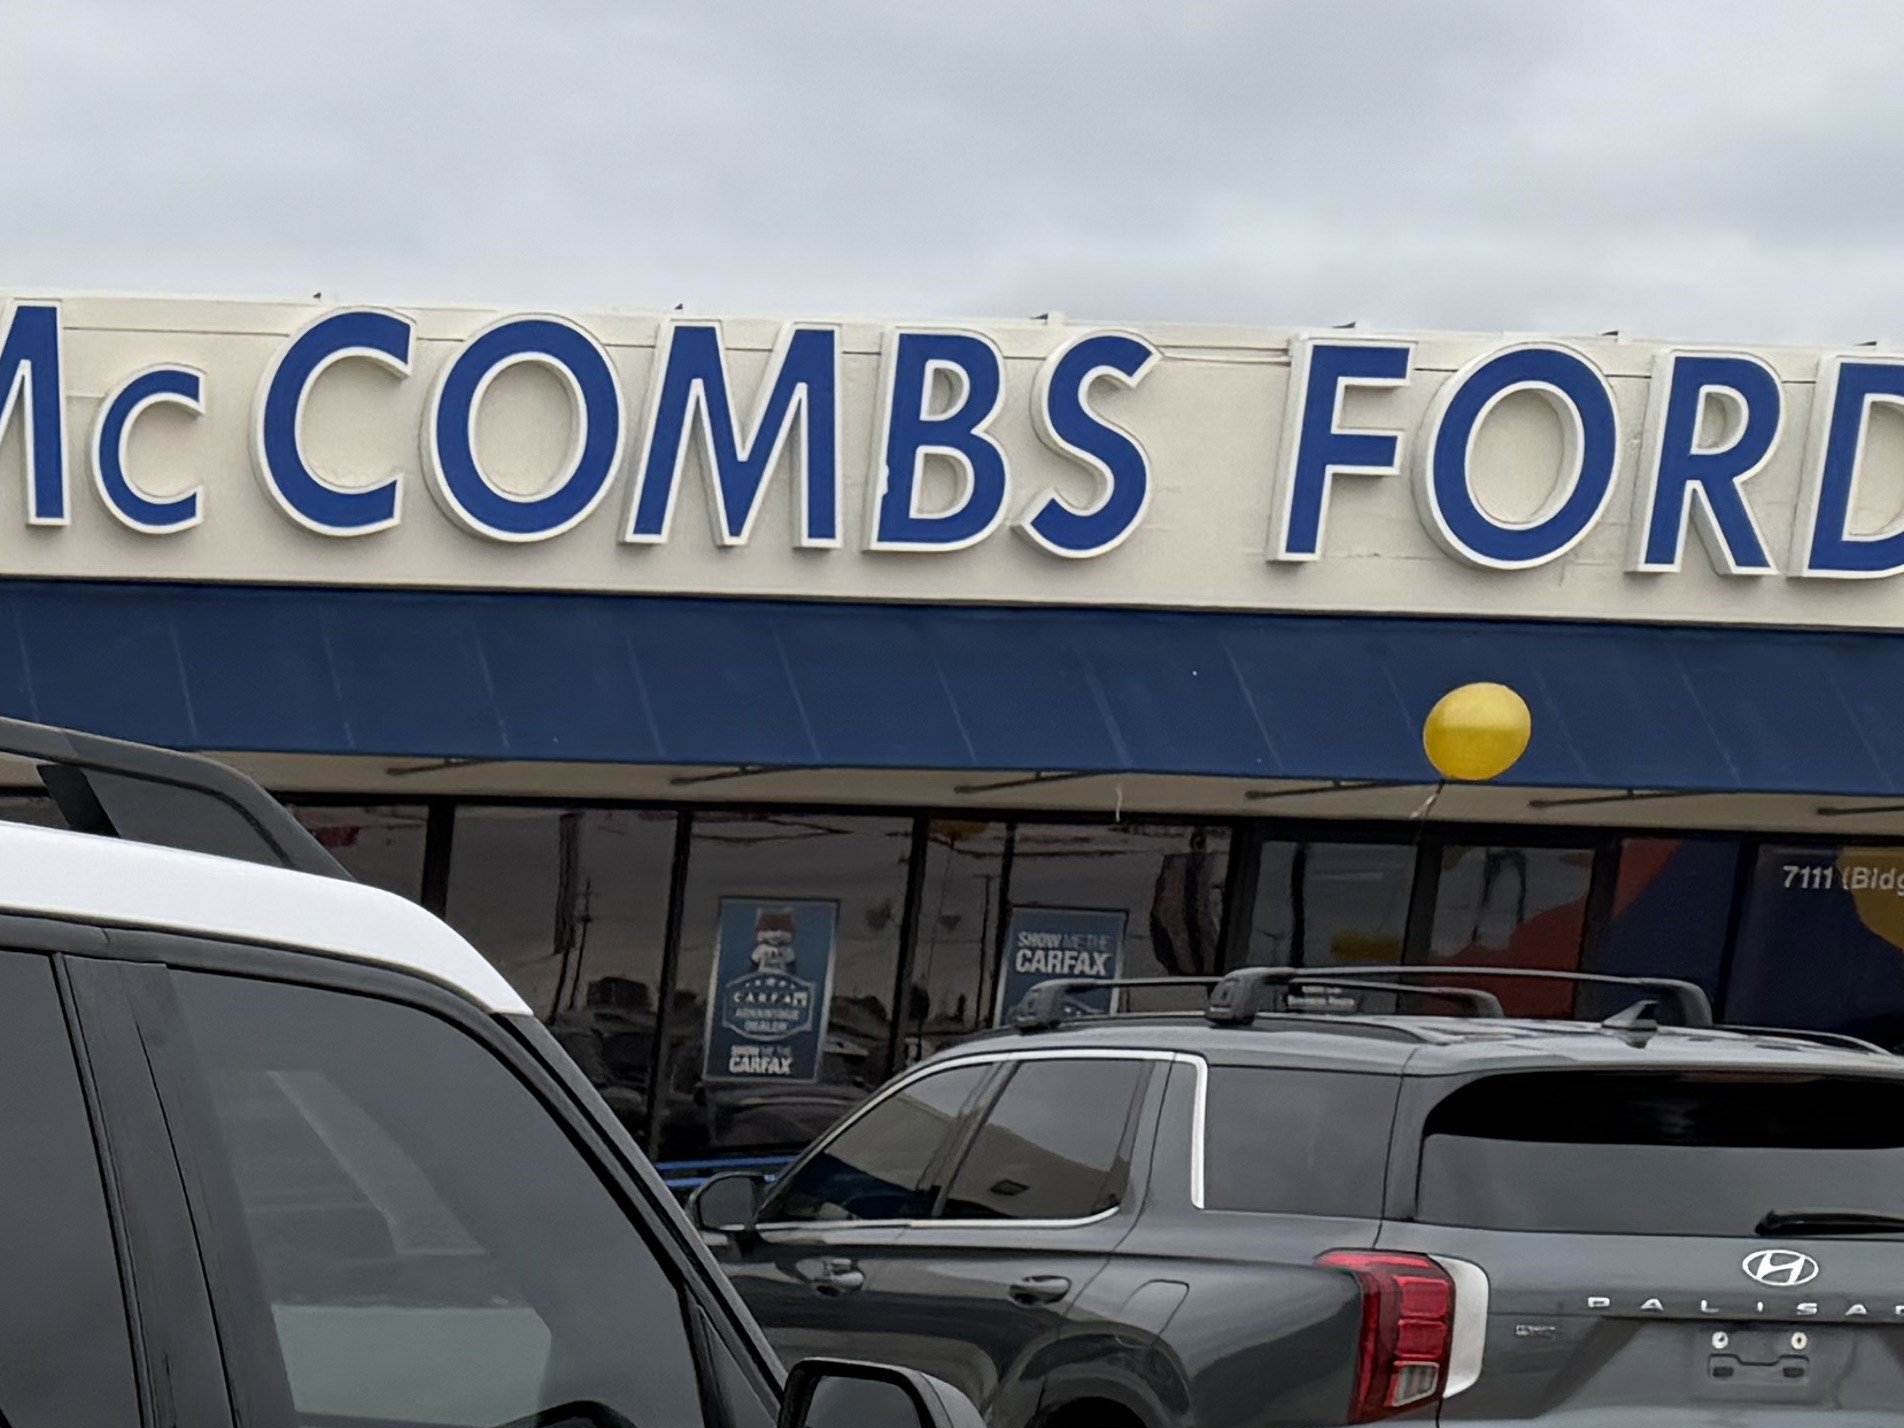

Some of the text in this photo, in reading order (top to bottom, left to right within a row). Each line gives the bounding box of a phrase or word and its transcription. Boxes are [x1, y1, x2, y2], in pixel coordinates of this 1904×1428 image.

[1268, 334, 1904, 579] FORD
[1783, 865, 1833, 889] 7111
[1016, 948, 1111, 976] CARFAX
[729, 1056, 792, 1074] CARFAX
